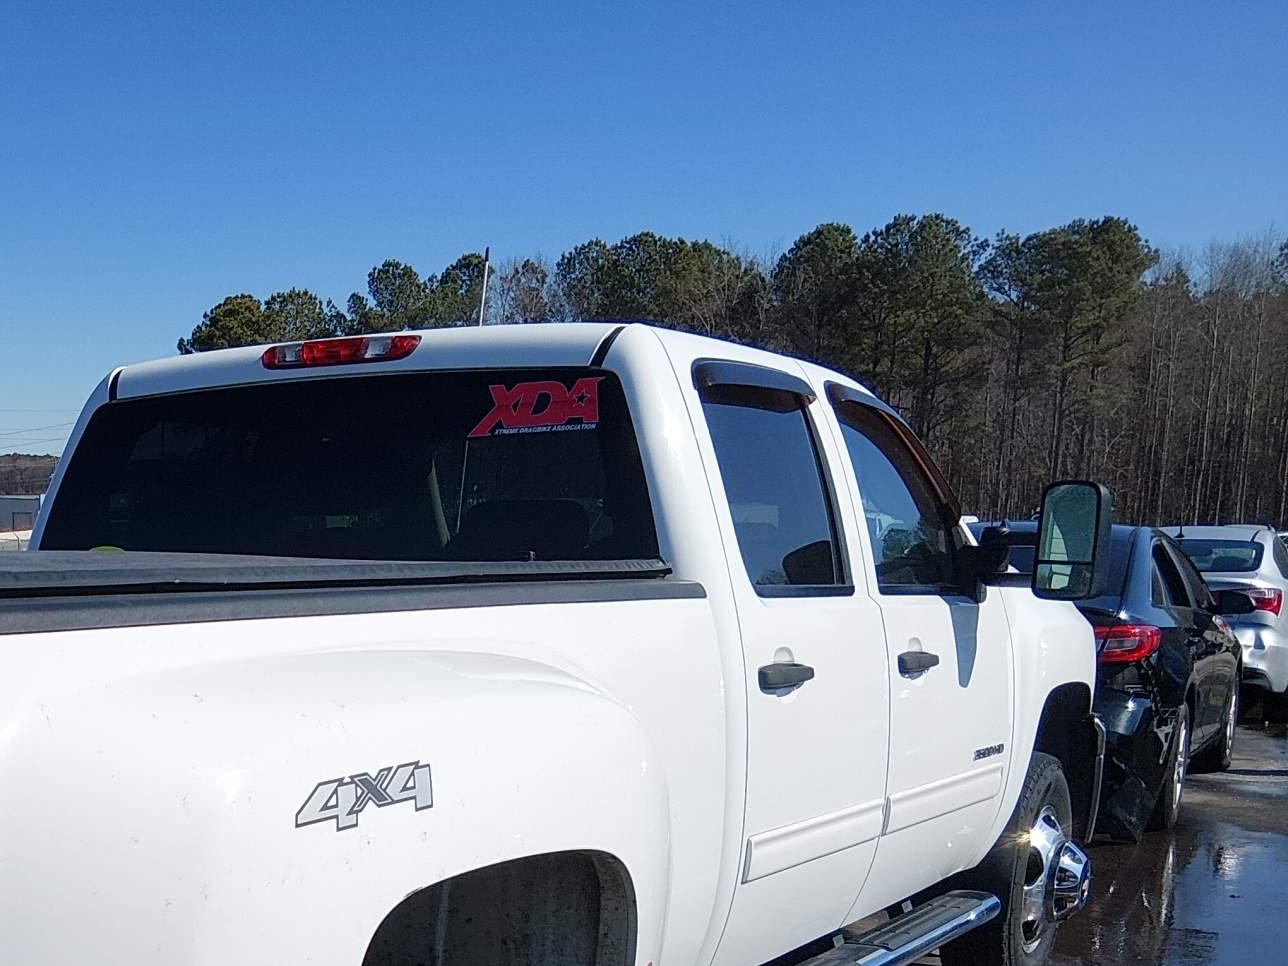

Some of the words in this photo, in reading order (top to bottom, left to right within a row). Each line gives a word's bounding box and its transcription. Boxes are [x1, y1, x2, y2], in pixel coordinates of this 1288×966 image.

[467, 376, 606, 438] XDA
[493, 427, 519, 436] XTREME
[551, 423, 597, 433] ASSOCIATION
